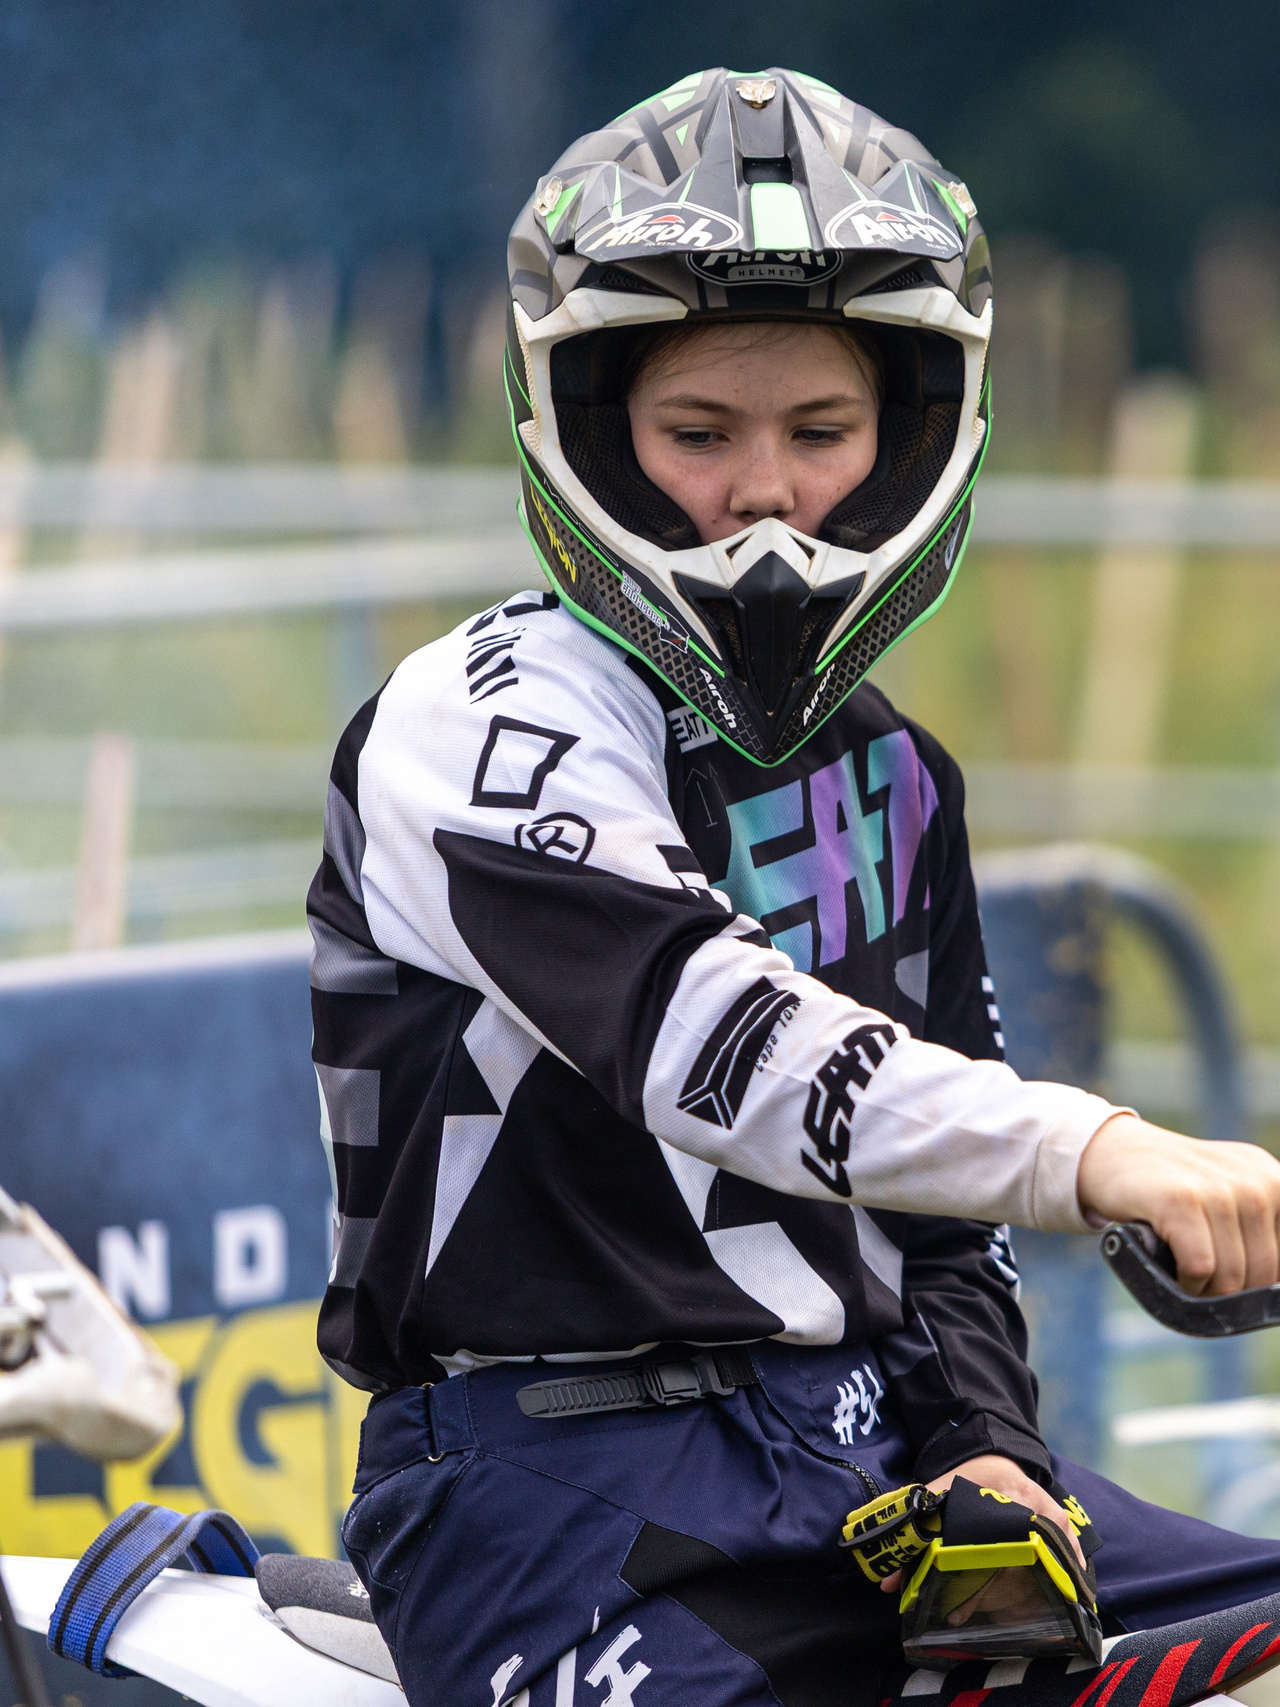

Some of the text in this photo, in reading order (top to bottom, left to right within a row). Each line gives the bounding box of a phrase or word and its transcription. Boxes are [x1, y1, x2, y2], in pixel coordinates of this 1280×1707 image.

[584, 212, 714, 253] Airoh
[850, 212, 957, 249] Airoh
[699, 667, 737, 729] Airoh
